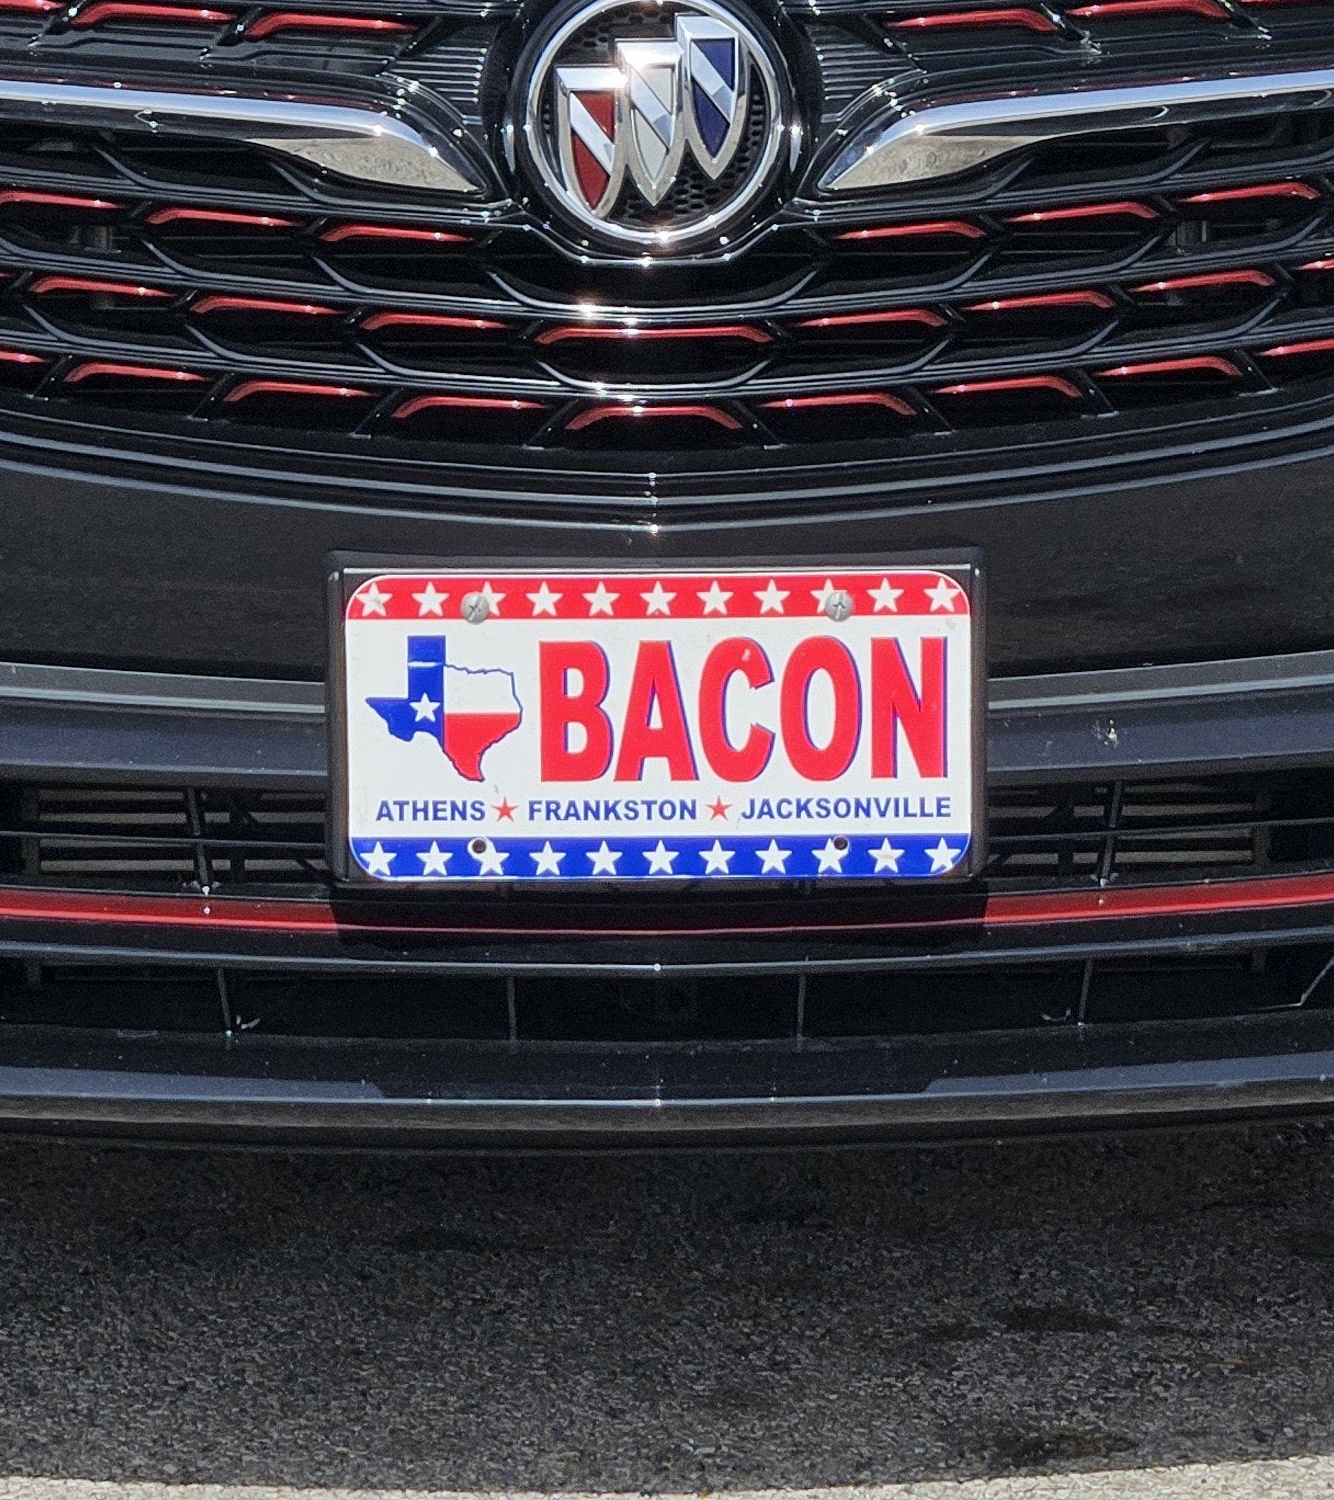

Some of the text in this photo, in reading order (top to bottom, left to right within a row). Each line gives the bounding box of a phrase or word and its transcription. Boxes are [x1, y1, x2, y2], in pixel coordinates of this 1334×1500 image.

[538, 636, 948, 782] BACON
[375, 796, 952, 822] ATHENS FRANKSTON JACKSONVILLE
